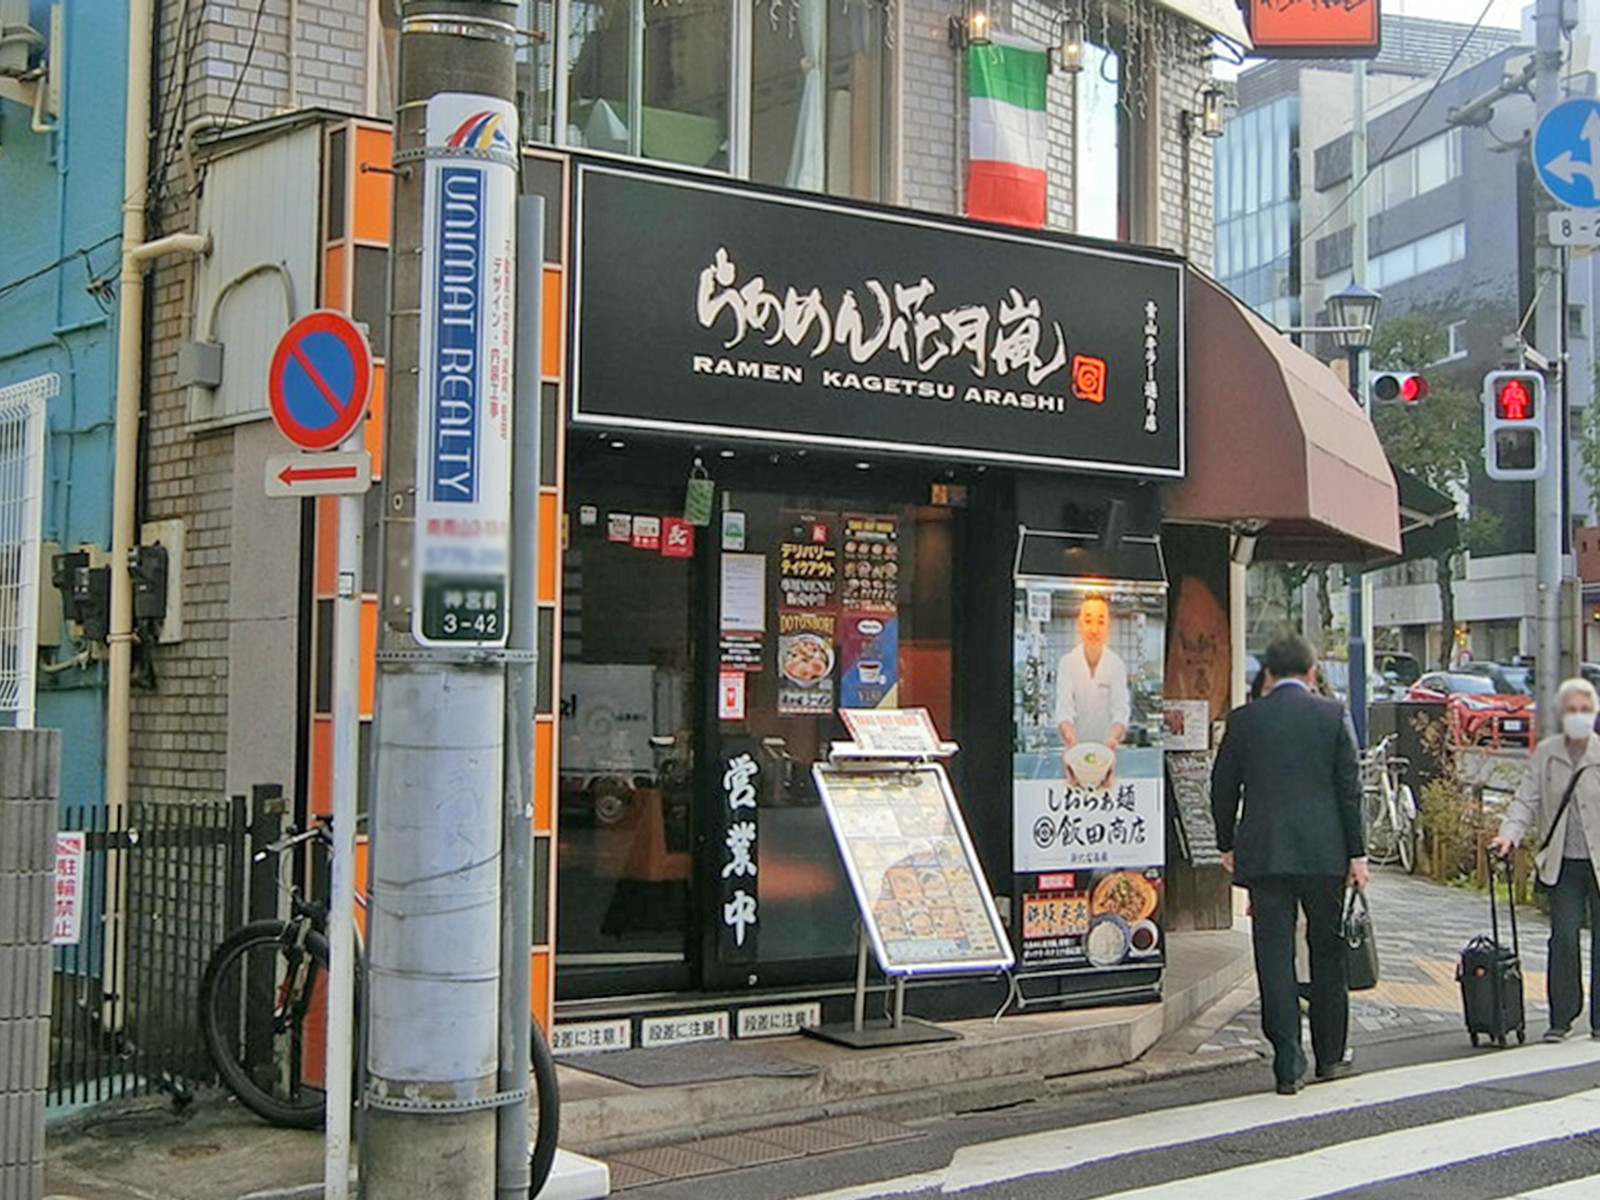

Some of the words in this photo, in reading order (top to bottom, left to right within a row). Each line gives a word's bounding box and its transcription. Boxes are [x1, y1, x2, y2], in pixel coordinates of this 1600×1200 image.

[443, 174, 478, 333] UNIMAT
[692, 355, 803, 385] RAMEN
[822, 369, 955, 401] KAGETSU
[964, 385, 1066, 414] ARASHI
[438, 347, 474, 494] REALTY
[780, 542, 837, 561] デリバリー
[780, 560, 836, 577] テイクアウト
[443, 613, 497, 633] 3-42
[721, 753, 760, 947] 営業中
[1055, 814, 1146, 847] 飯田商店
[53, 858, 77, 938] 駐輪禁止
